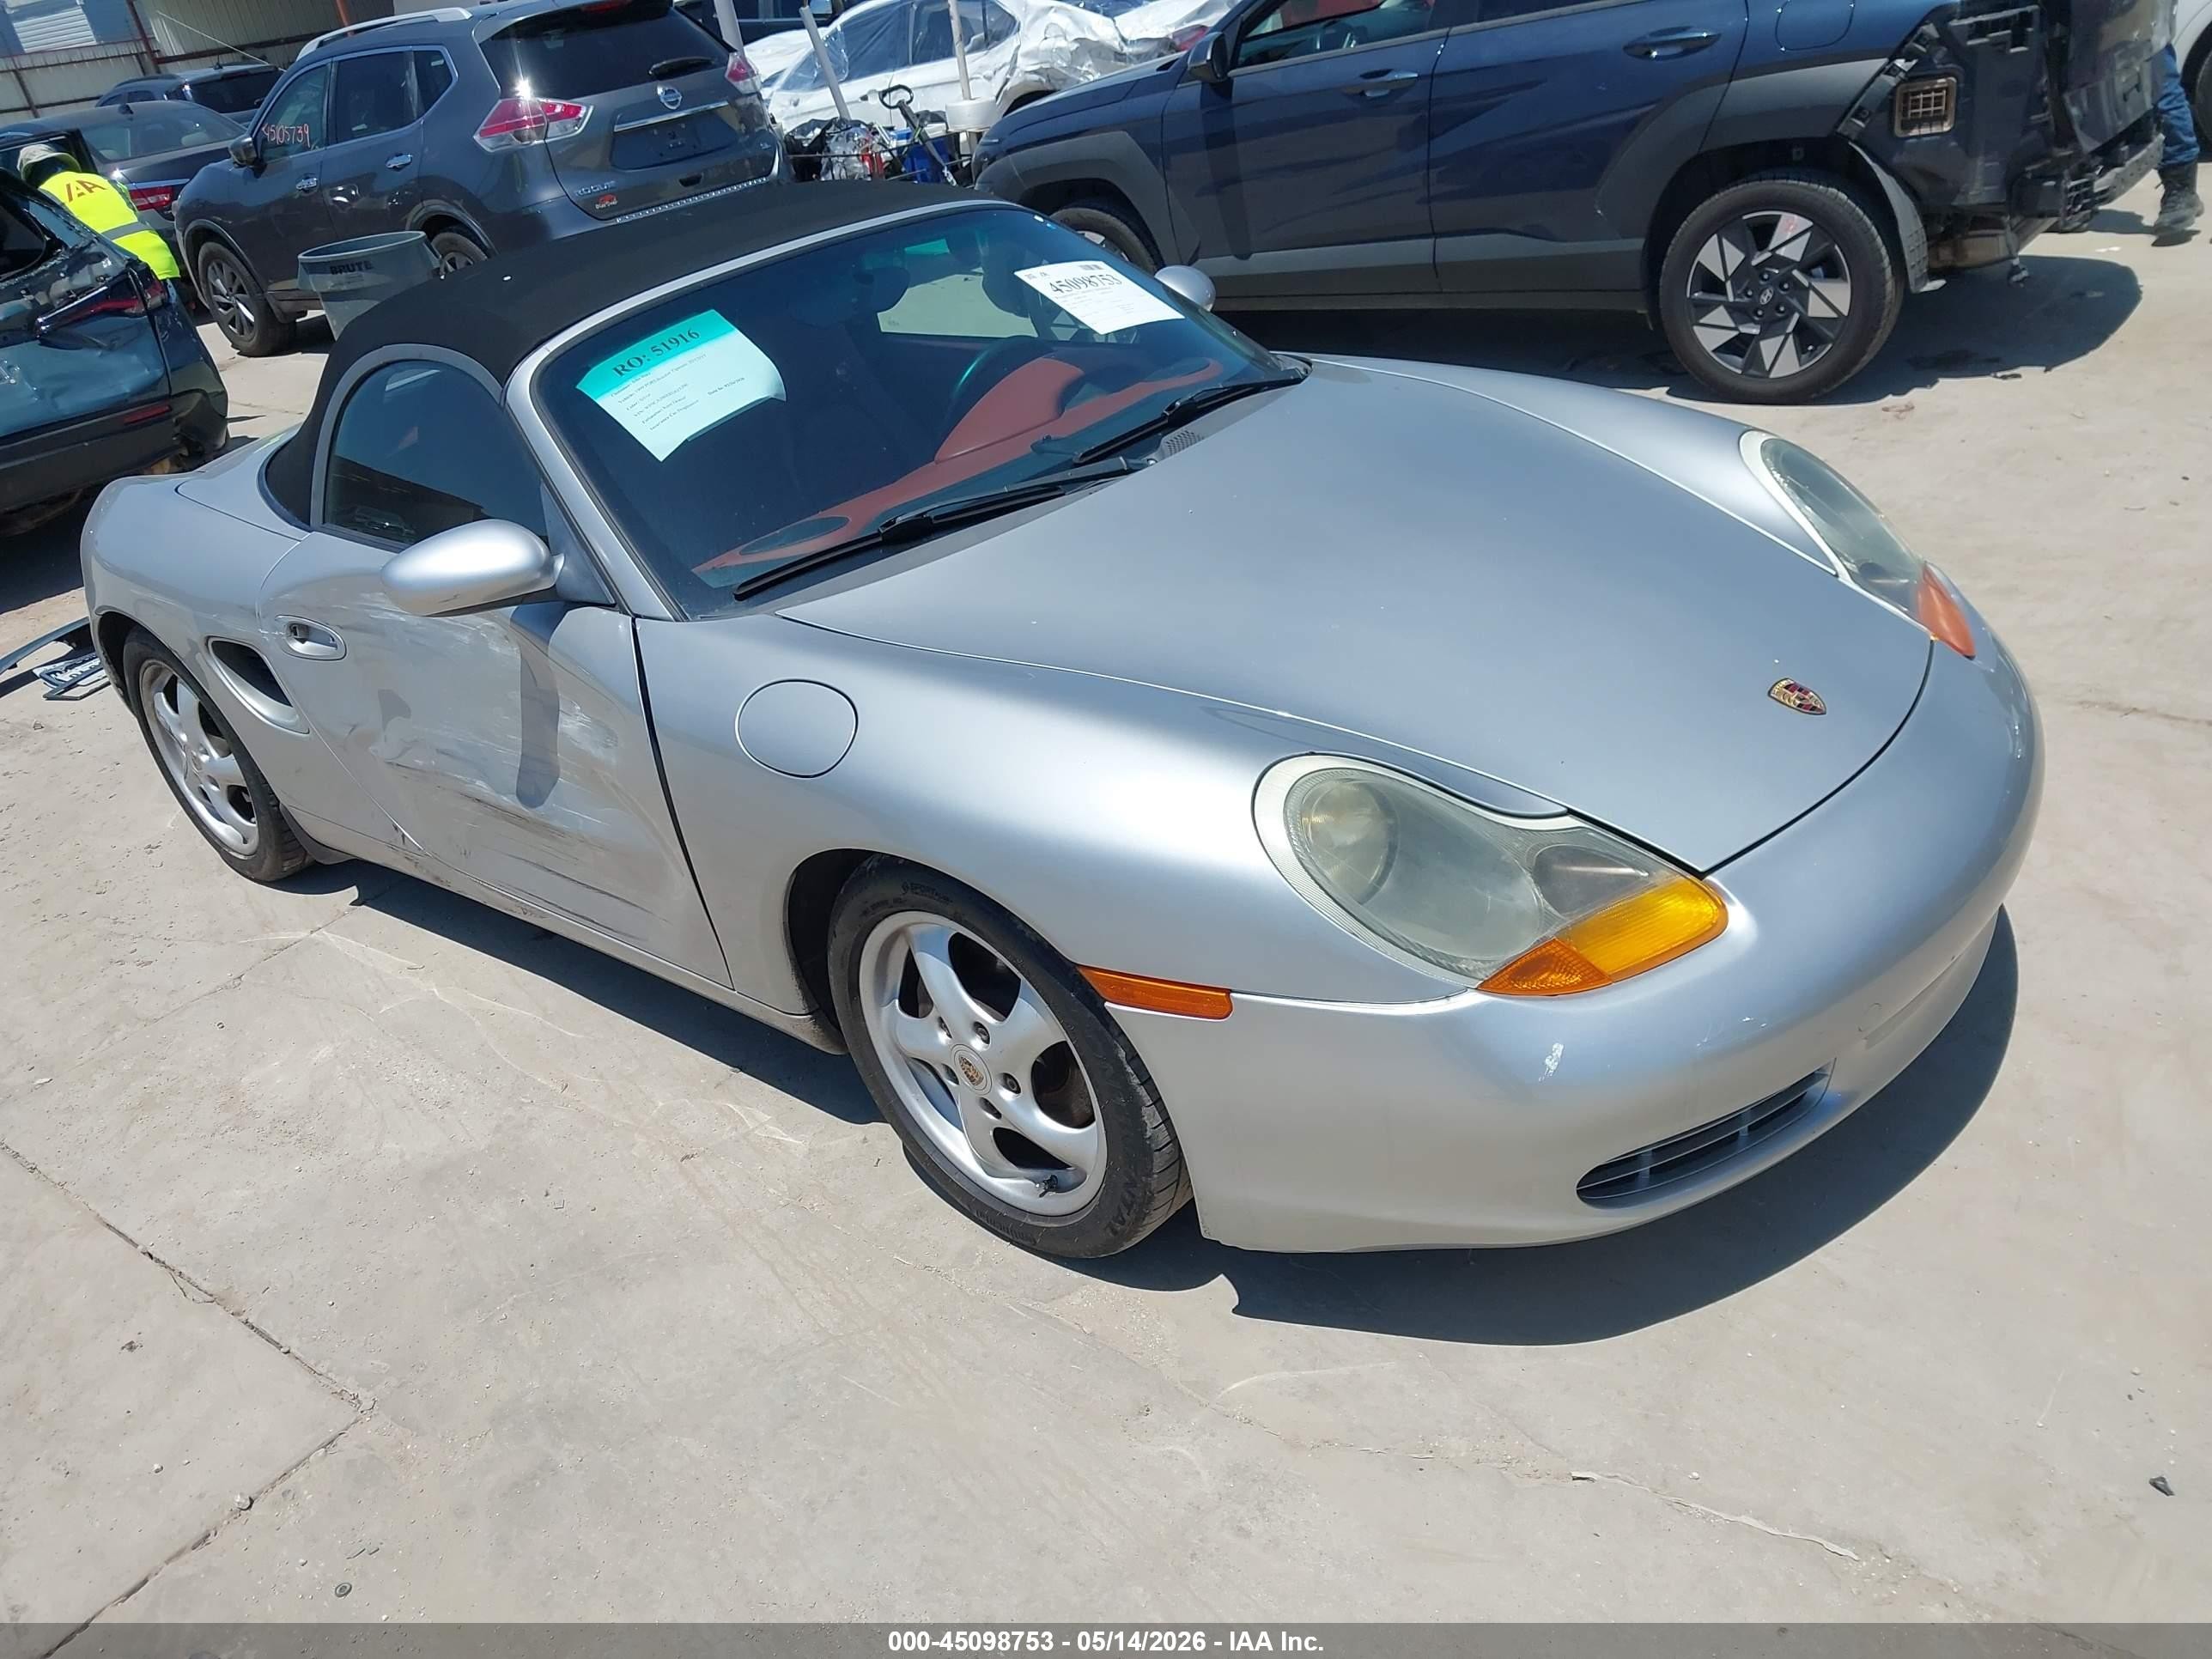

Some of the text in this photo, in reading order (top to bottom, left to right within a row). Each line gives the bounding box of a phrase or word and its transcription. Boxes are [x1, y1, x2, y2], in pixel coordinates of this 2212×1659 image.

[330, 260, 373, 275] BRUTE
[1049, 274, 1122, 294] 45098753
[613, 329, 700, 377] RO: 51916
